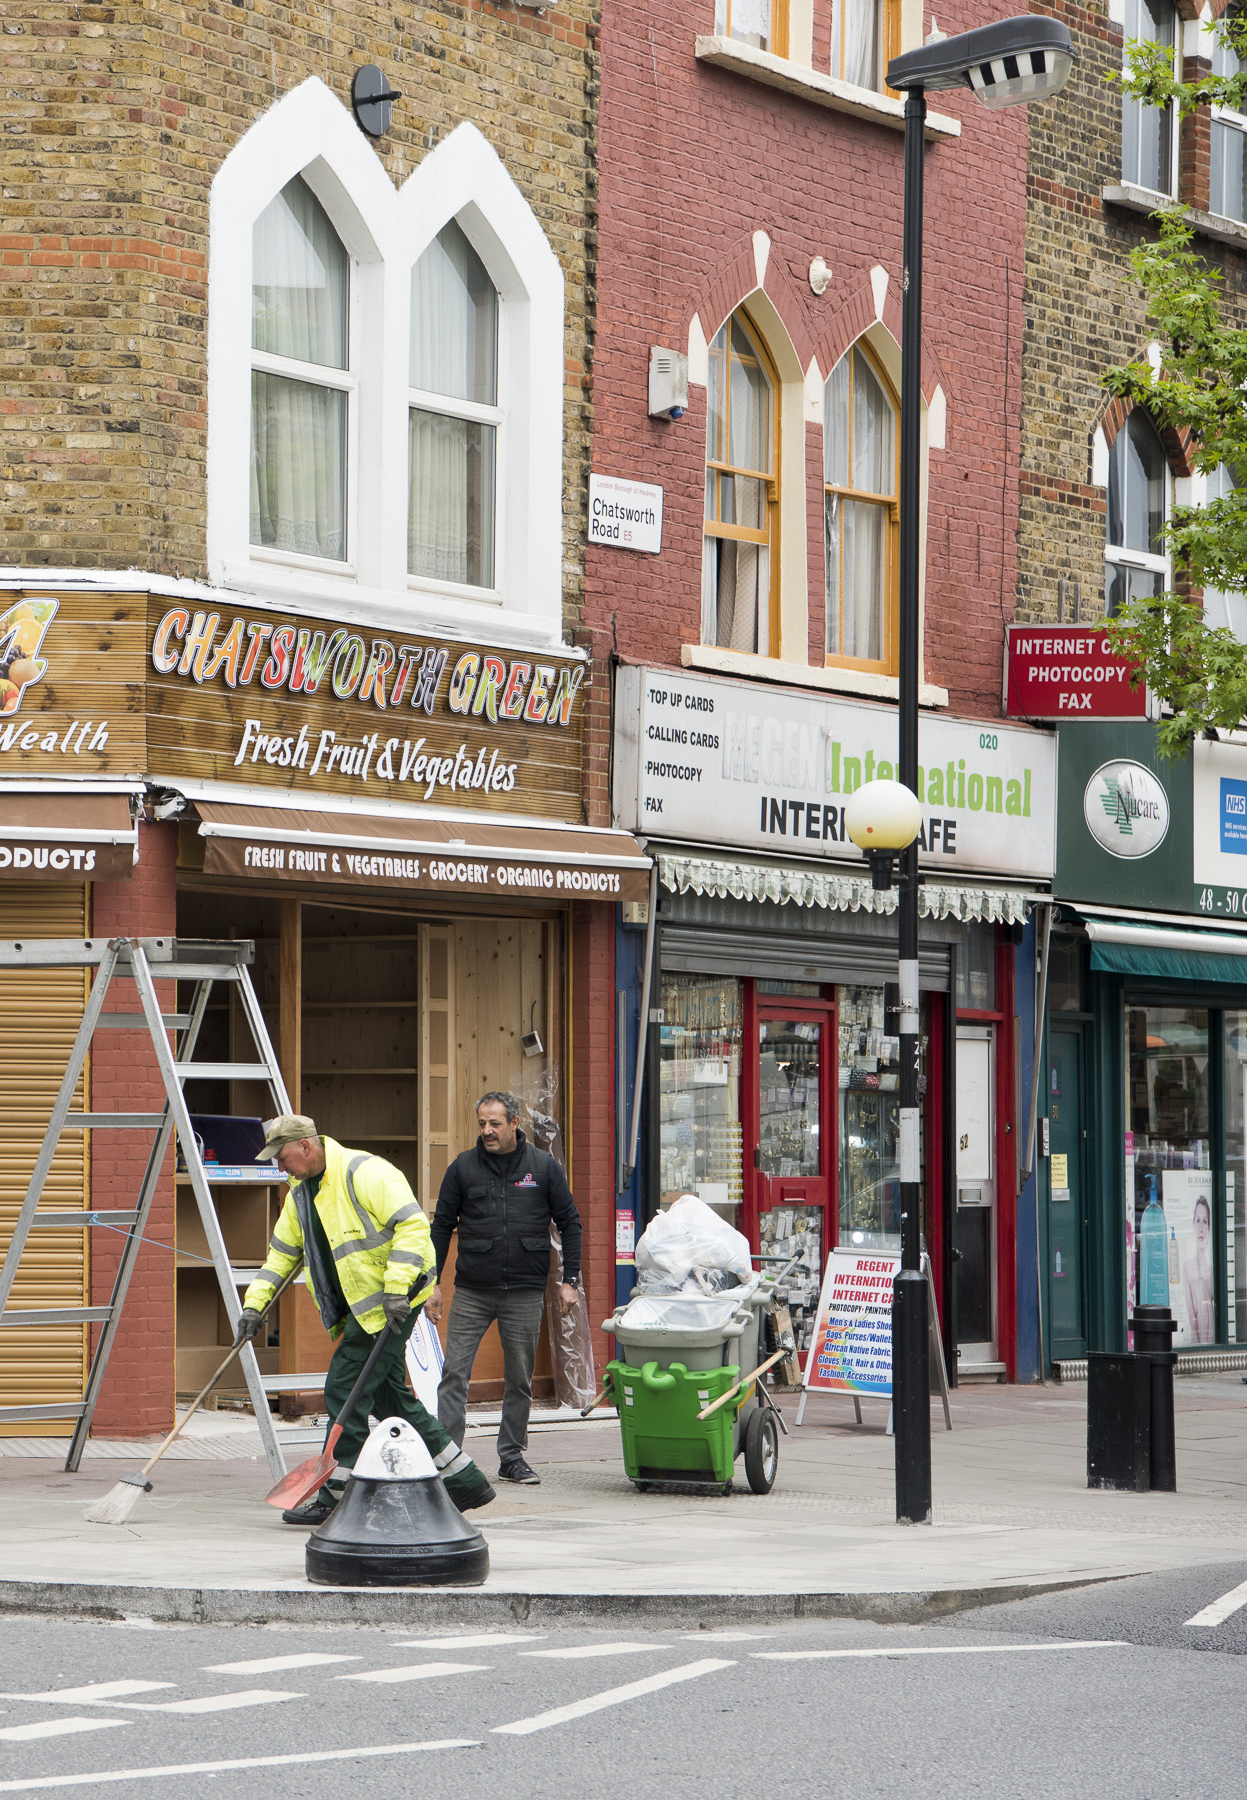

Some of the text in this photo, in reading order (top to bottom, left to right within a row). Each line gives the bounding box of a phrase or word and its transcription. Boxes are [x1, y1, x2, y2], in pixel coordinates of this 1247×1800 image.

[597, 480, 613, 490] London
[614, 484, 632, 495] Borough
[639, 489, 657, 498] Hackney
[593, 498, 655, 525] Chatsworth
[592, 519, 633, 541] Road E5
[1016, 639, 1096, 655] INTERNET
[153, 607, 585, 726] CHATSWORTH GREEN
[1028, 666, 1127, 682] PHOTOCOPY
[649, 689, 714, 713] TOP UP CARDS
[1058, 693, 1092, 709] FAX
[648, 725, 719, 749] CALLING CARDS
[979, 733, 998, 750] 020
[233, 719, 517, 800] Fresh Fruit & Vegetables
[647, 761, 702, 782] PHOTOCOPY
[646, 797, 663, 813] FAX
[1226, 795, 1245, 814] NHS
[245, 846, 285, 869] FRESH
[288, 849, 327, 872] FRUIT
[331, 854, 341, 873] &
[347, 854, 420, 880] VEGETABLES
[429, 861, 489, 884] GROCERY
[496, 866, 554, 889] ORGANIC
[556, 870, 621, 893] PRODUCTS
[1200, 888, 1213, 911] 48
[1226, 891, 1239, 913] 50
[960, 1133, 969, 1152] 52
[856, 1260, 895, 1273] REGENT
[834, 1274, 893, 1288] INTERNATIO
[832, 1290, 879, 1304] INTERNET
[865, 1306, 892, 1316] PRINTING
[828, 1317, 892, 1330] Men's & Ladies Shoe
[824, 1342, 848, 1353] African
[849, 1344, 869, 1355] Native
[855, 1358, 869, 1368] Hair
[870, 1361, 875, 1369] &
[846, 1370, 887, 1382] Accessories
